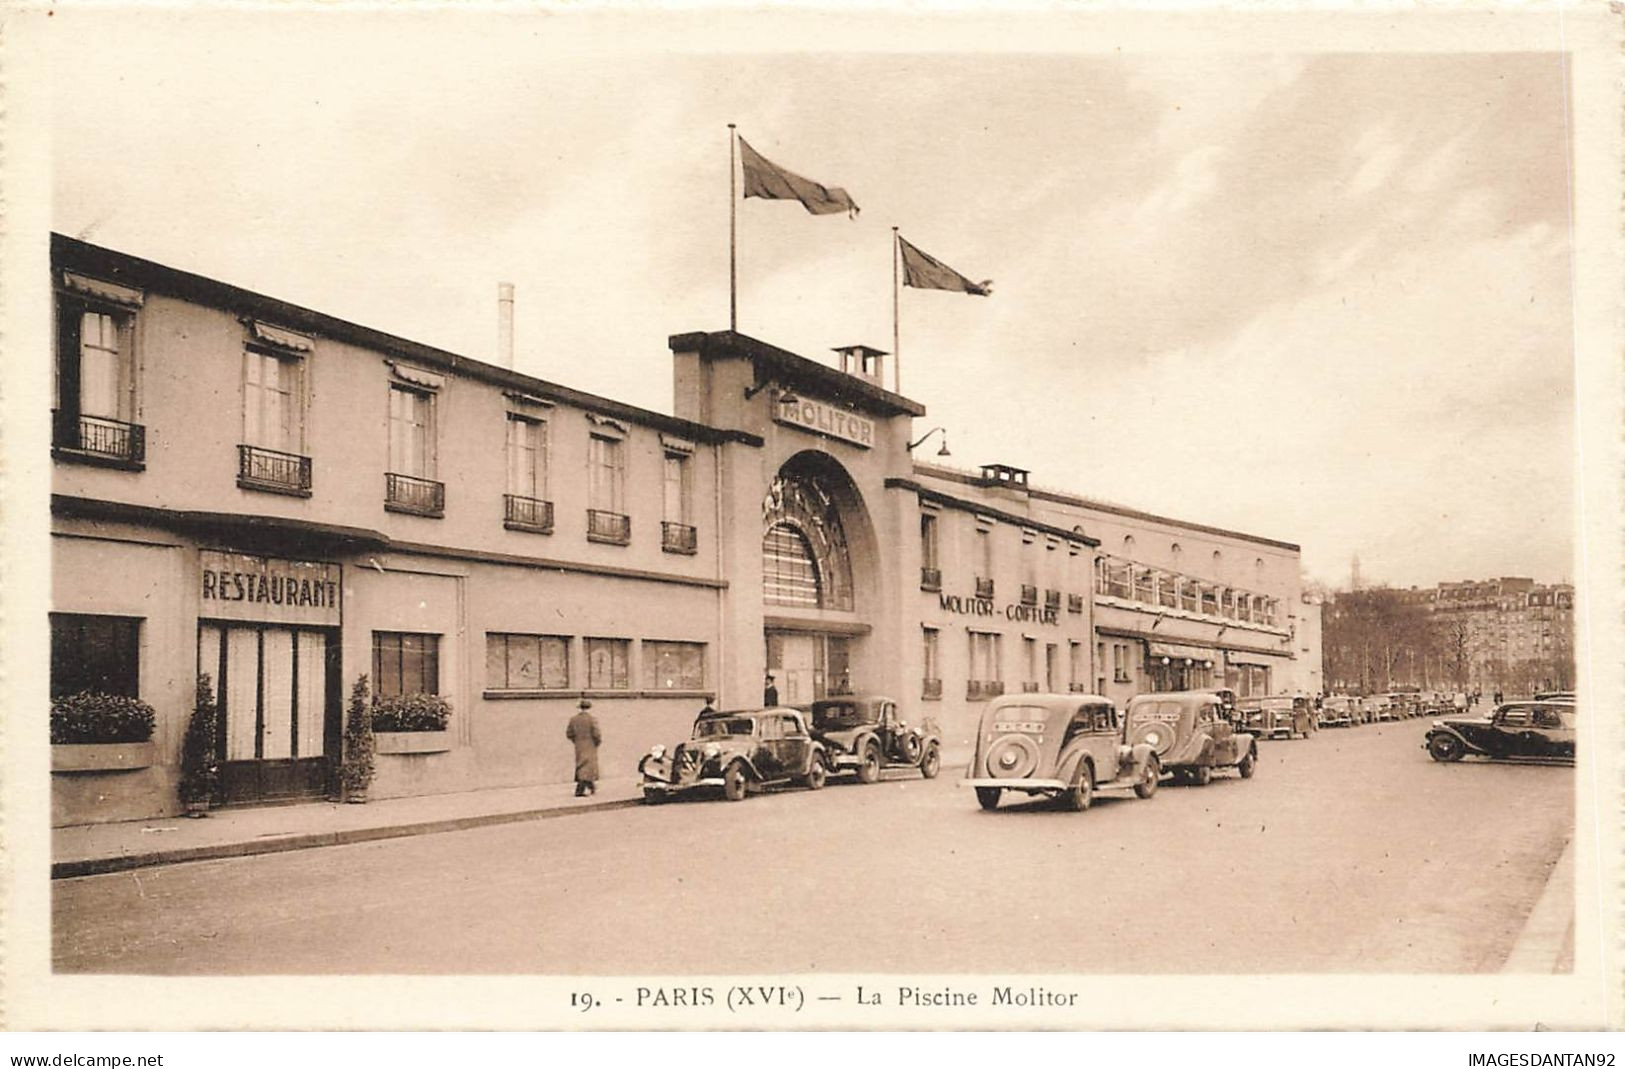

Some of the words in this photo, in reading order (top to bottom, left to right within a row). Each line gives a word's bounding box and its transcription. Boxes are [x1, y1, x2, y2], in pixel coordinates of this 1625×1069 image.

[783, 401, 872, 444] MOLITOR
[202, 569, 337, 608] RESTAURANT
[940, 593, 993, 616] MOLITOR
[1005, 604, 1059, 626] COIFFURE
